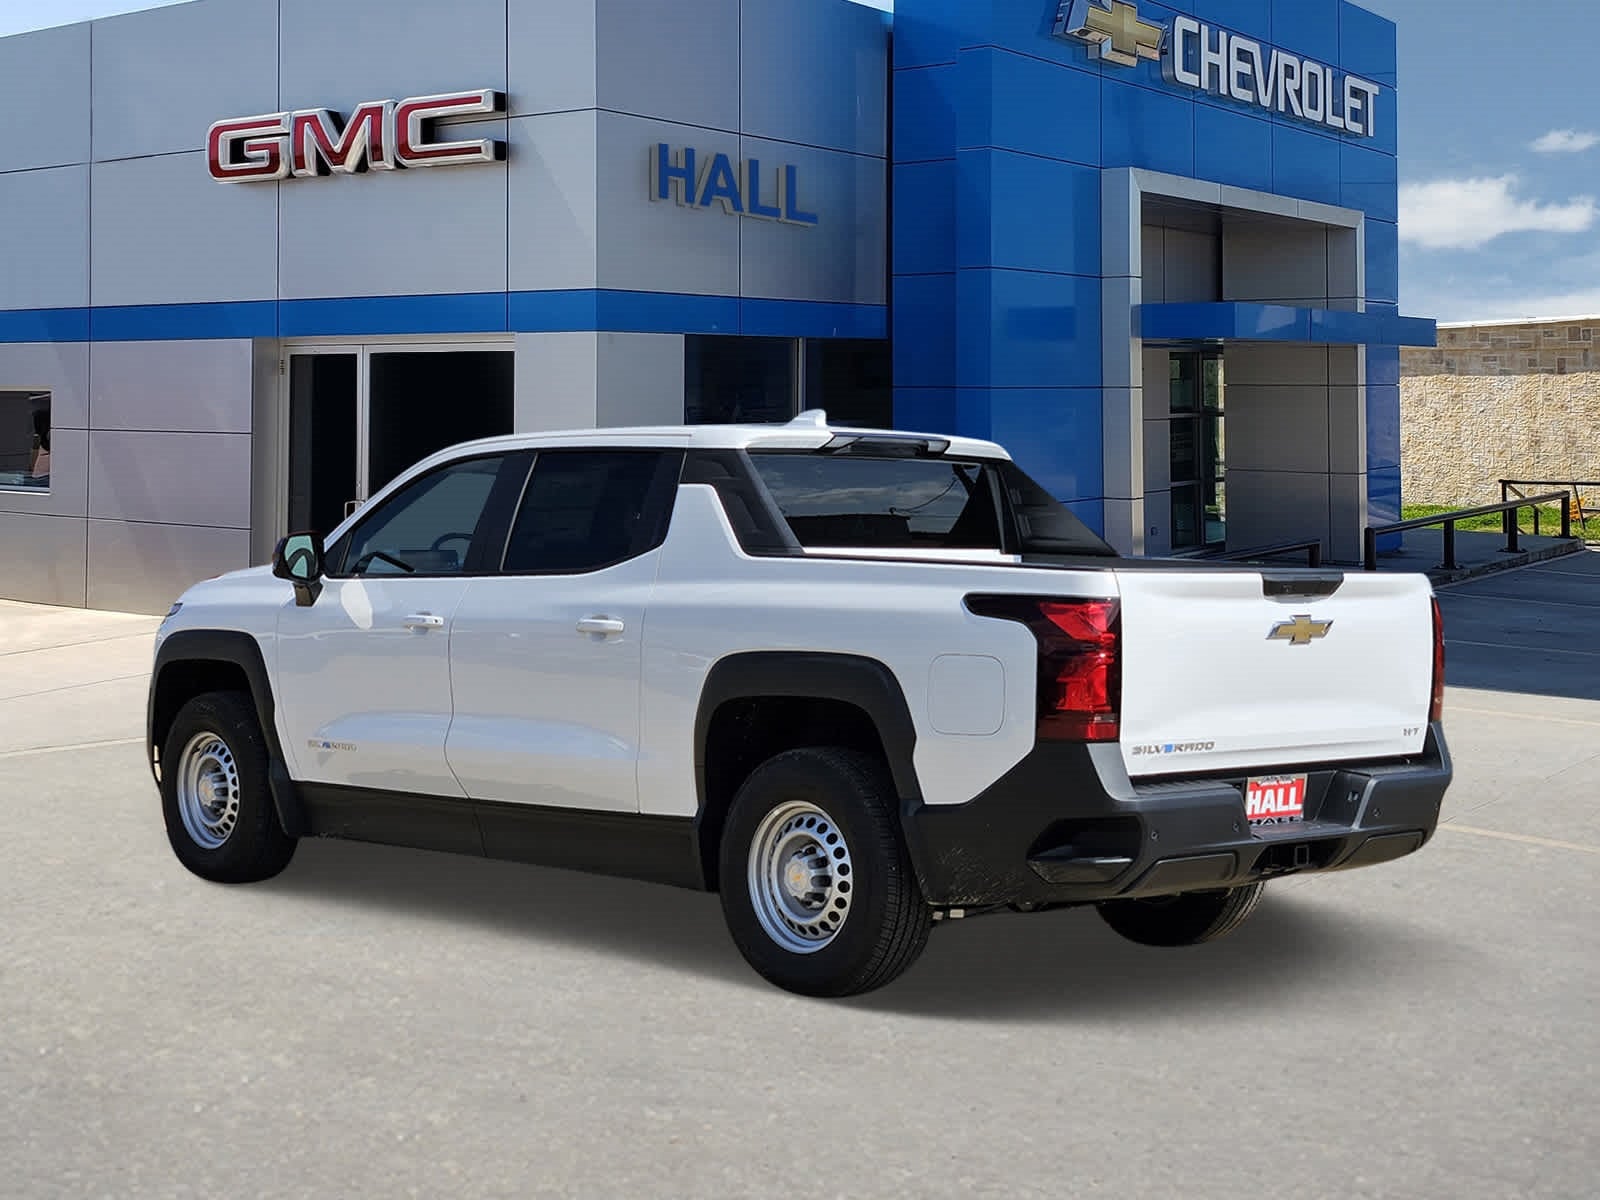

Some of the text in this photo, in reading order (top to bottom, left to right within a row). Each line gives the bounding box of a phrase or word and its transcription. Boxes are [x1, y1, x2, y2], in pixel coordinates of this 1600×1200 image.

[1174, 15, 1380, 137] CHEVROLET
[207, 88, 506, 184] GMC
[650, 143, 819, 227] HALL
[1247, 786, 1303, 815] HALL
